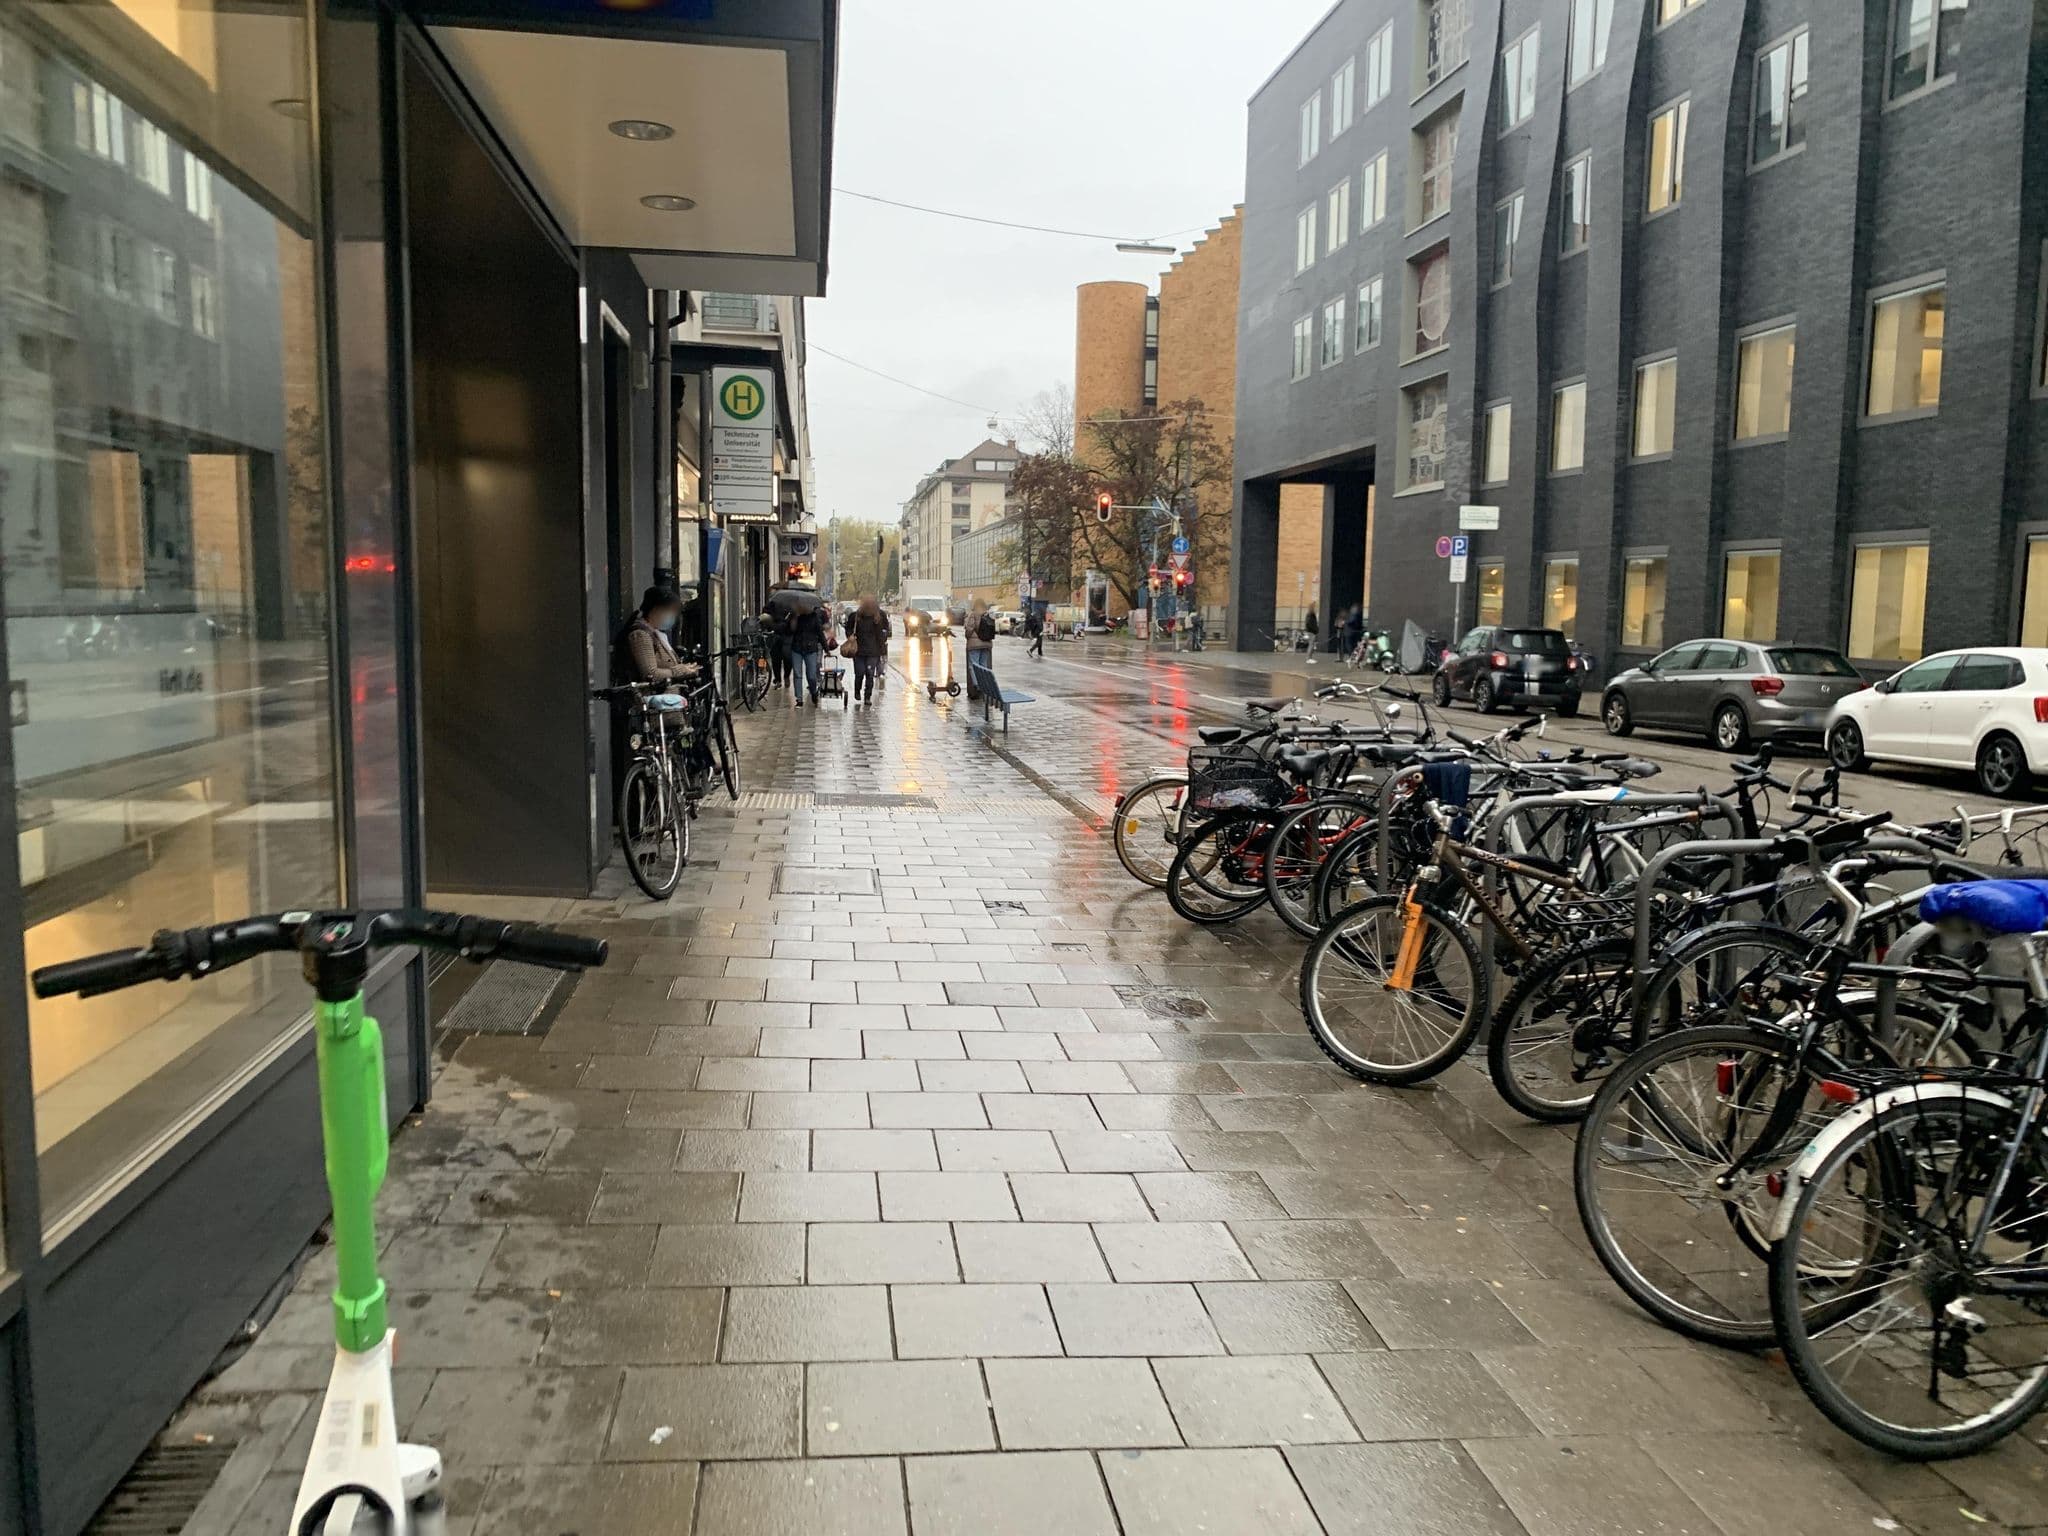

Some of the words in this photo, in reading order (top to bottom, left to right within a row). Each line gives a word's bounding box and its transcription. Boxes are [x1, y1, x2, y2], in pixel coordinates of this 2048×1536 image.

[734, 385, 751, 410] H
[724, 430, 760, 438] Technische
[724, 439, 761, 447] Universität
[1455, 539, 1465, 554] P
